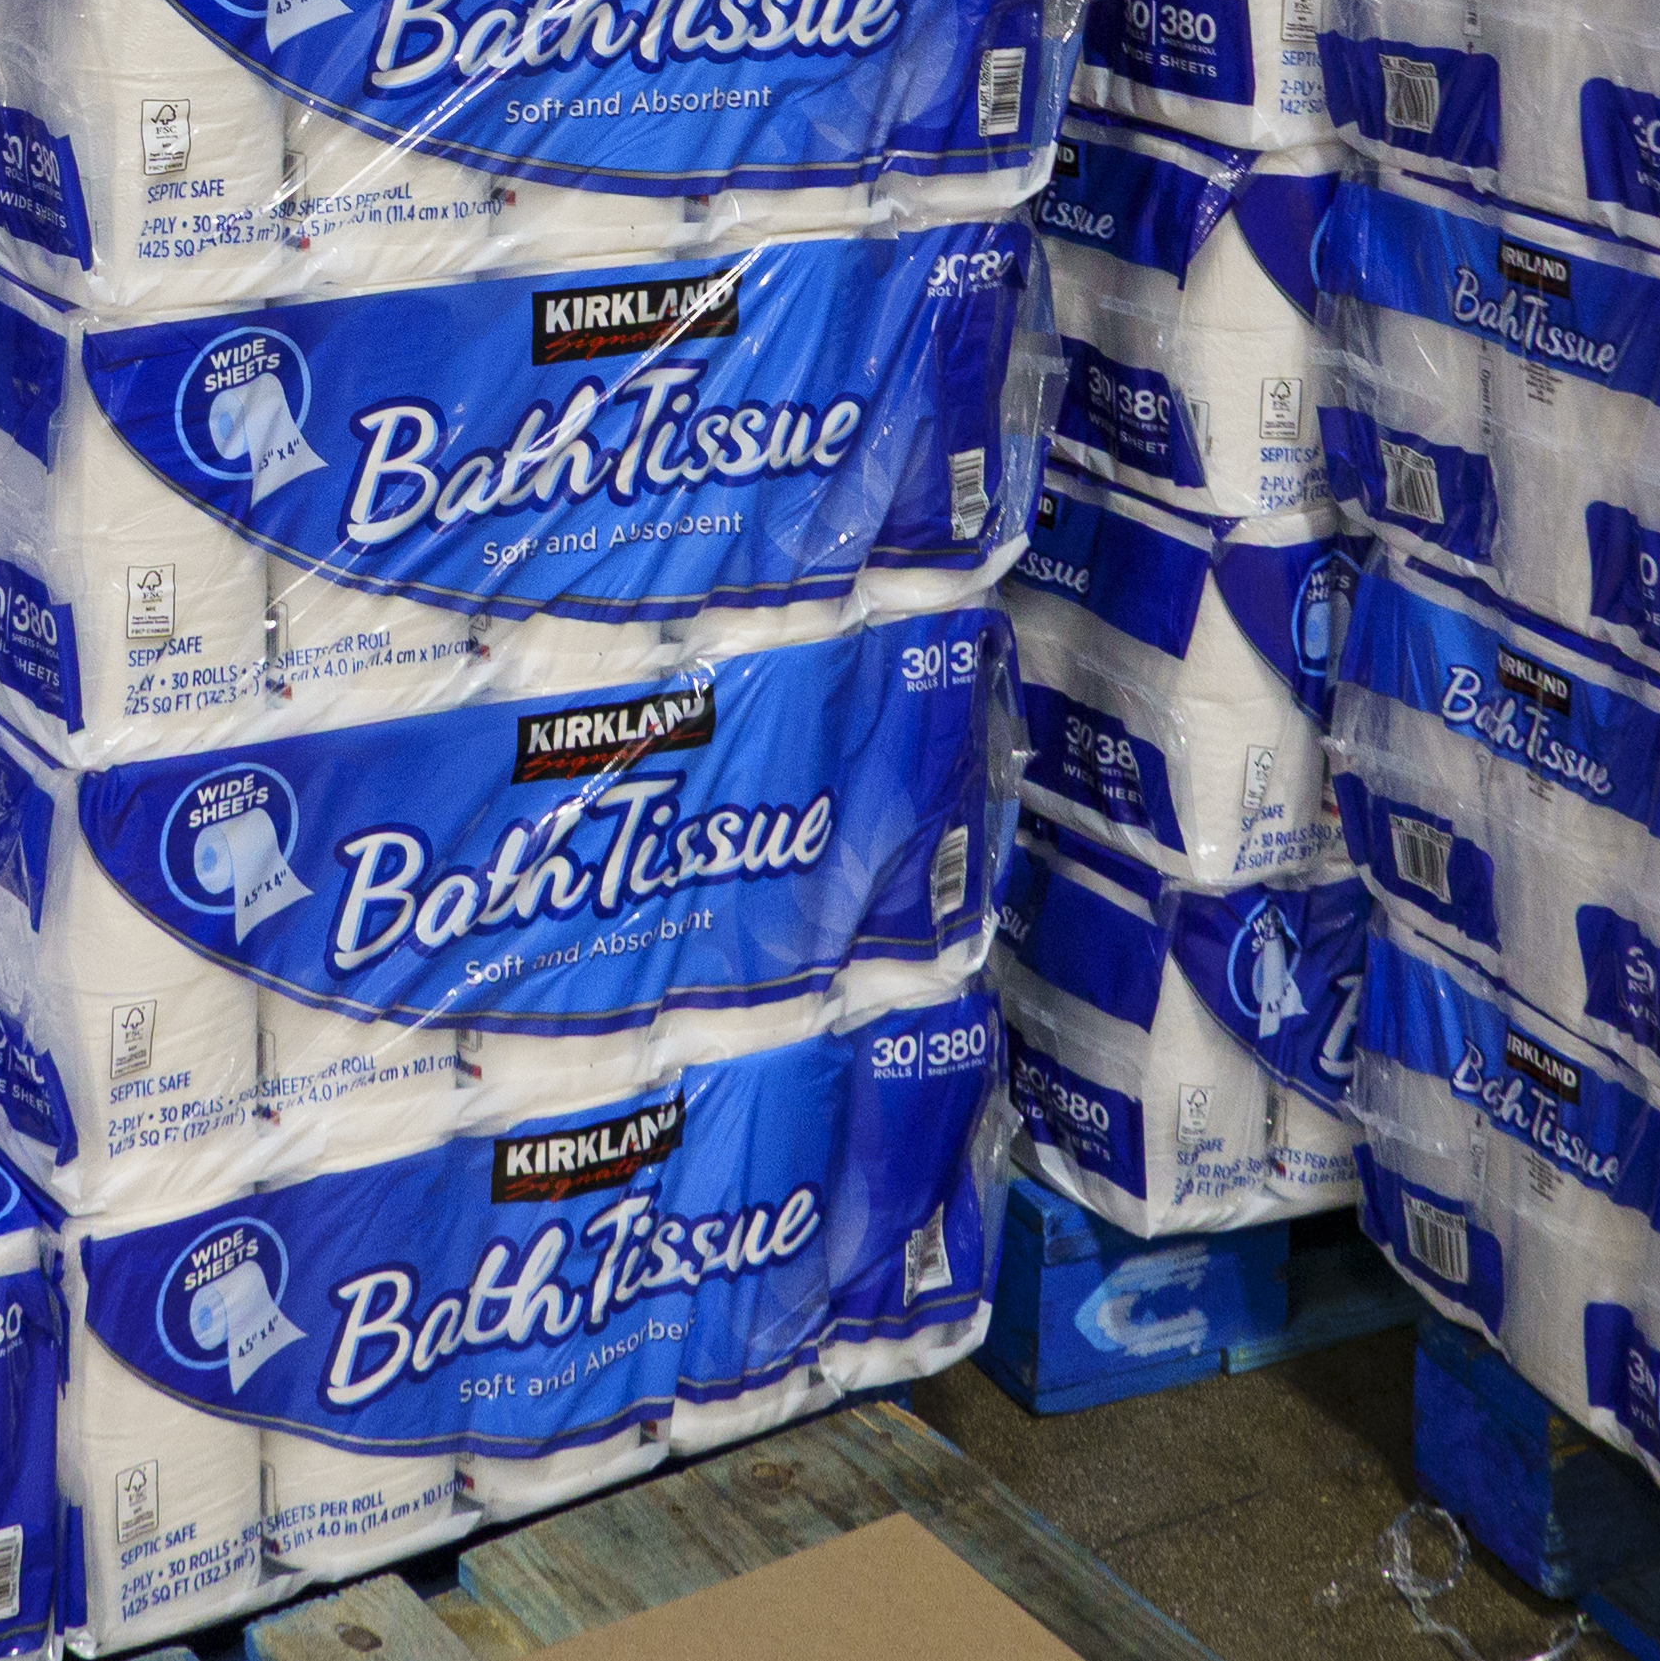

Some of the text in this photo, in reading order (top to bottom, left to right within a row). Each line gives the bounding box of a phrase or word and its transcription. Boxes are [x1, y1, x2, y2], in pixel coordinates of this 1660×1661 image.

[348, 366, 861, 544] Bath Tissue
[334, 780, 831, 971] Bath Tissue
[871, 1026, 987, 1069] 30 380
[330, 1191, 823, 1406] Bath Tissue
